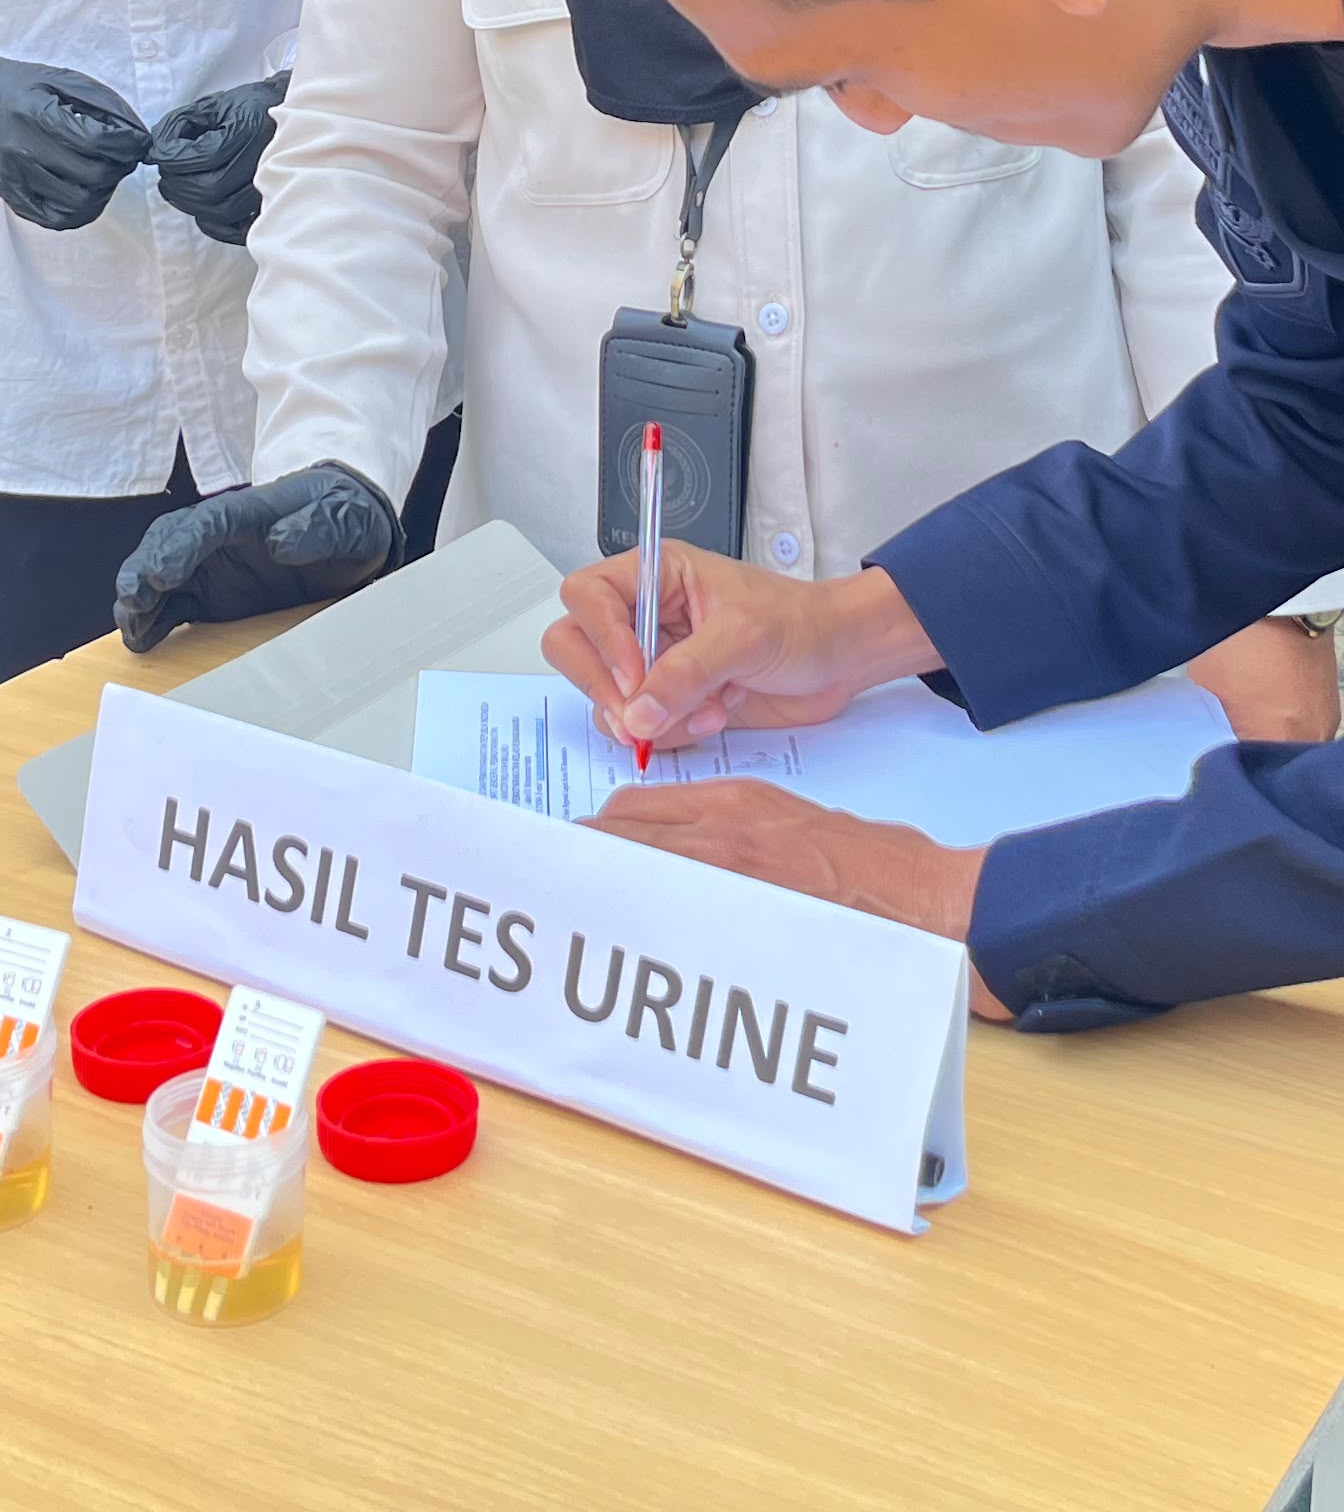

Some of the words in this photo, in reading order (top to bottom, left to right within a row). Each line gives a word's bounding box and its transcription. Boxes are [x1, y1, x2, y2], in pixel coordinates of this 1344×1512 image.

[158, 796, 370, 941] HASIL
[400, 872, 536, 994] TES
[564, 930, 849, 1106] URINE
